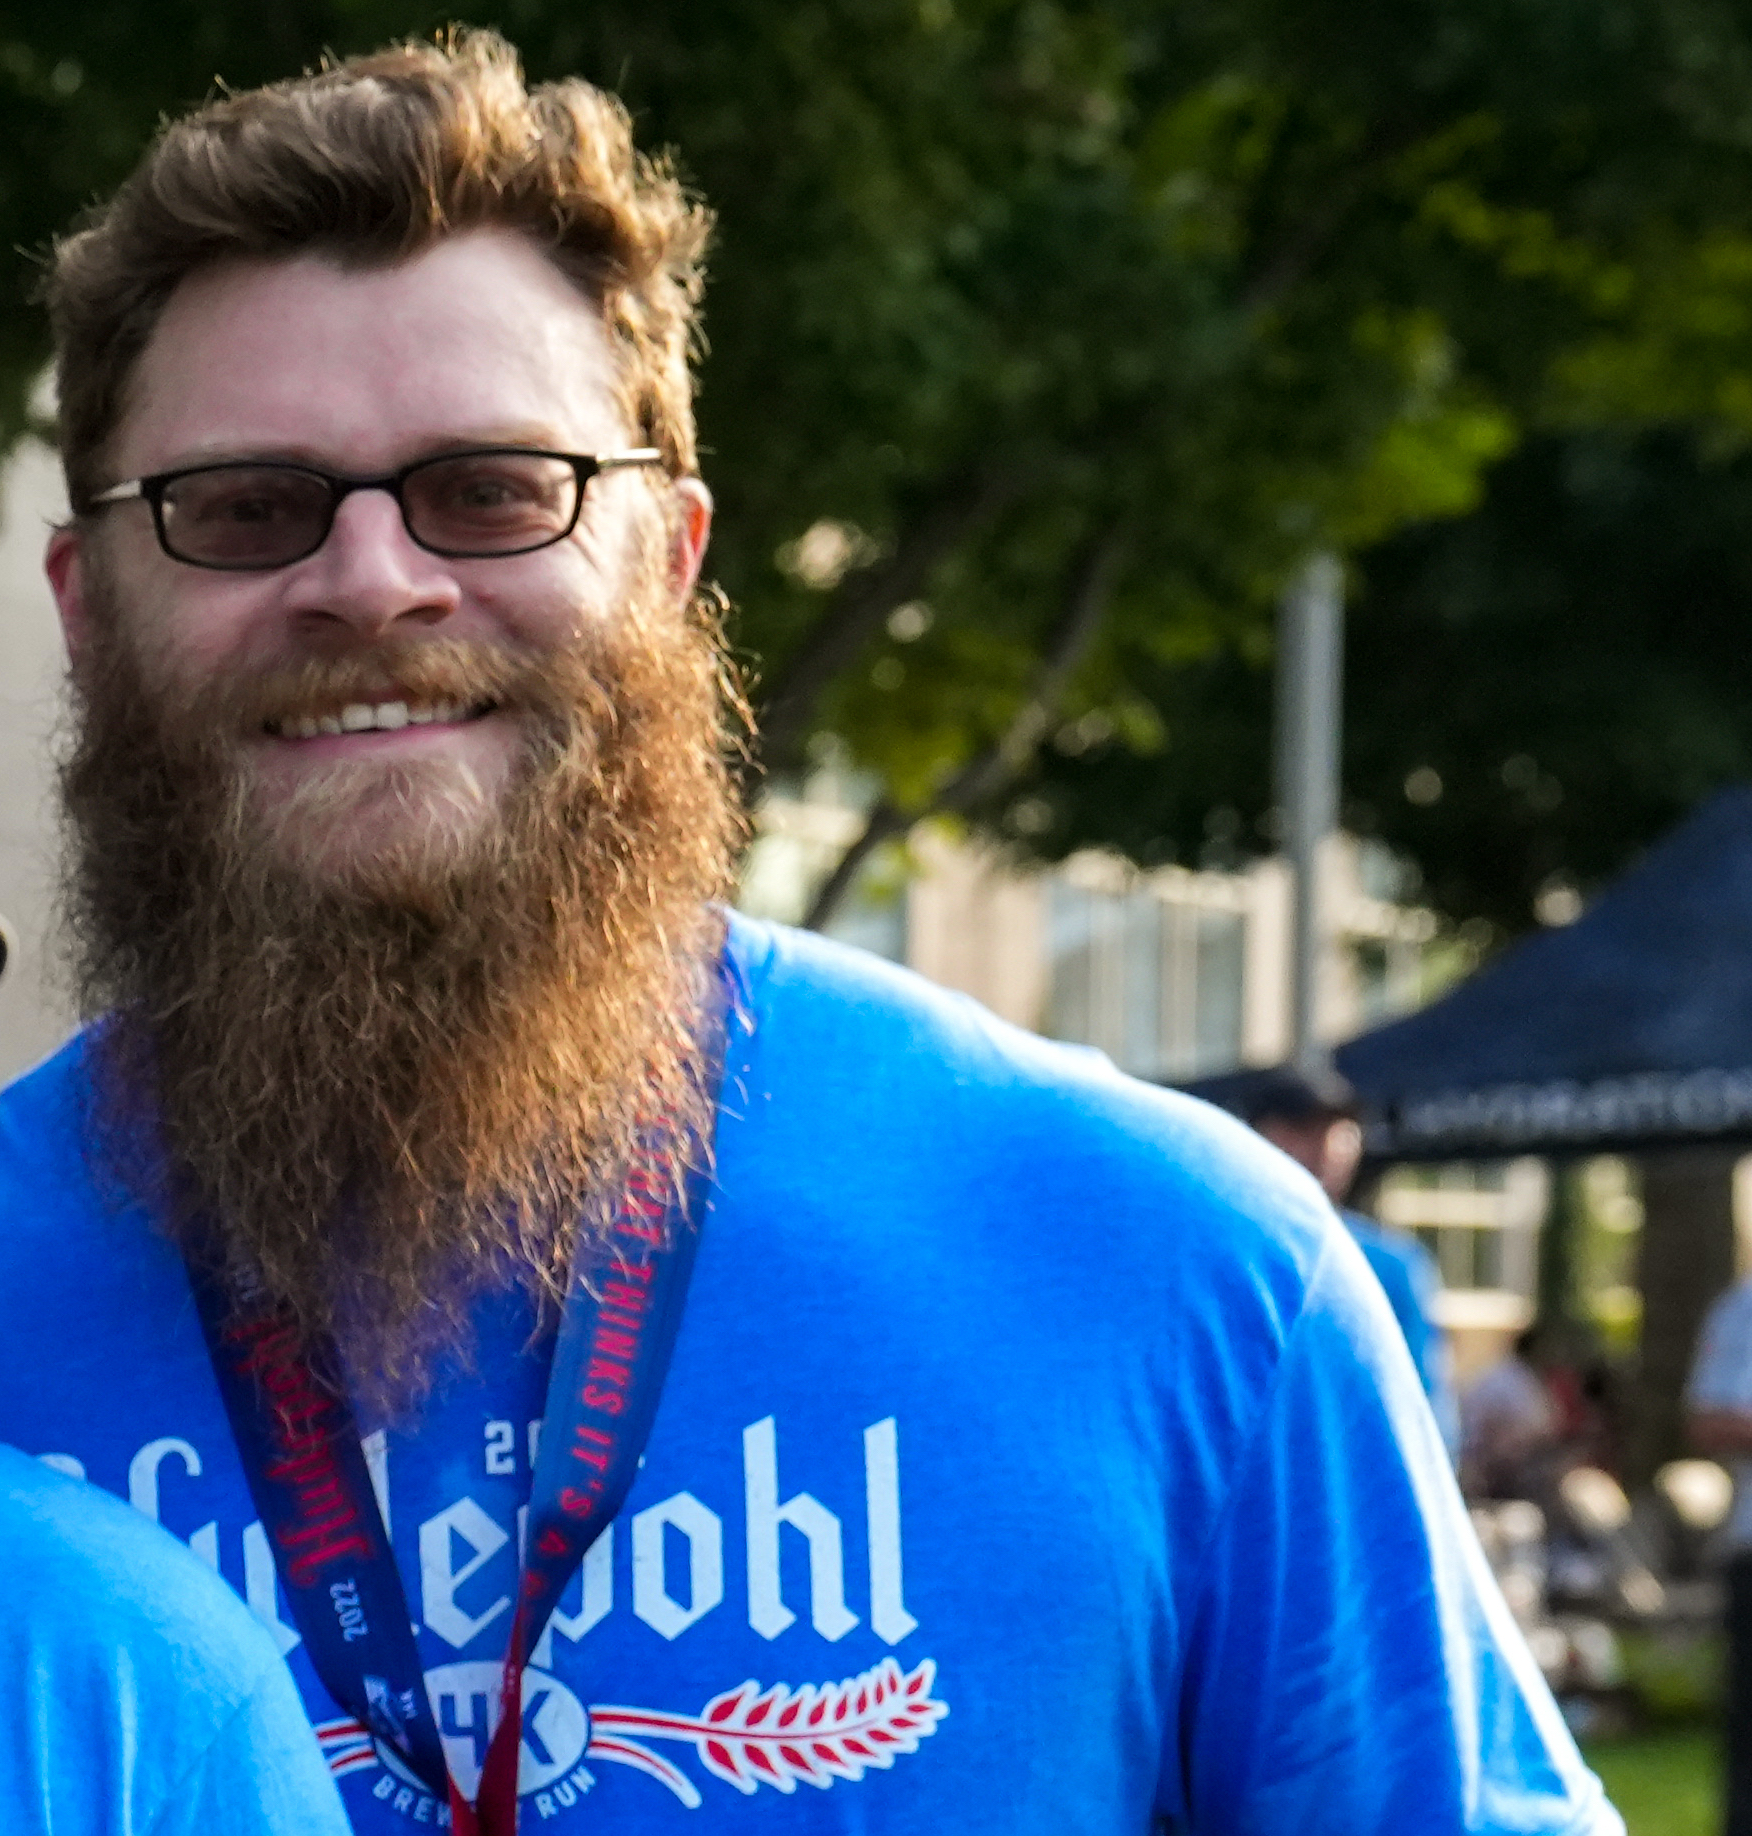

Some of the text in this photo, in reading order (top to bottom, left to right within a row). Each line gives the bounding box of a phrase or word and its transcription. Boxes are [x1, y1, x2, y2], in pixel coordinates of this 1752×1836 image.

[583, 1261, 652, 1415] THINKS
[329, 1577, 368, 1641] 2022
[536, 1767, 595, 1818] RUN
